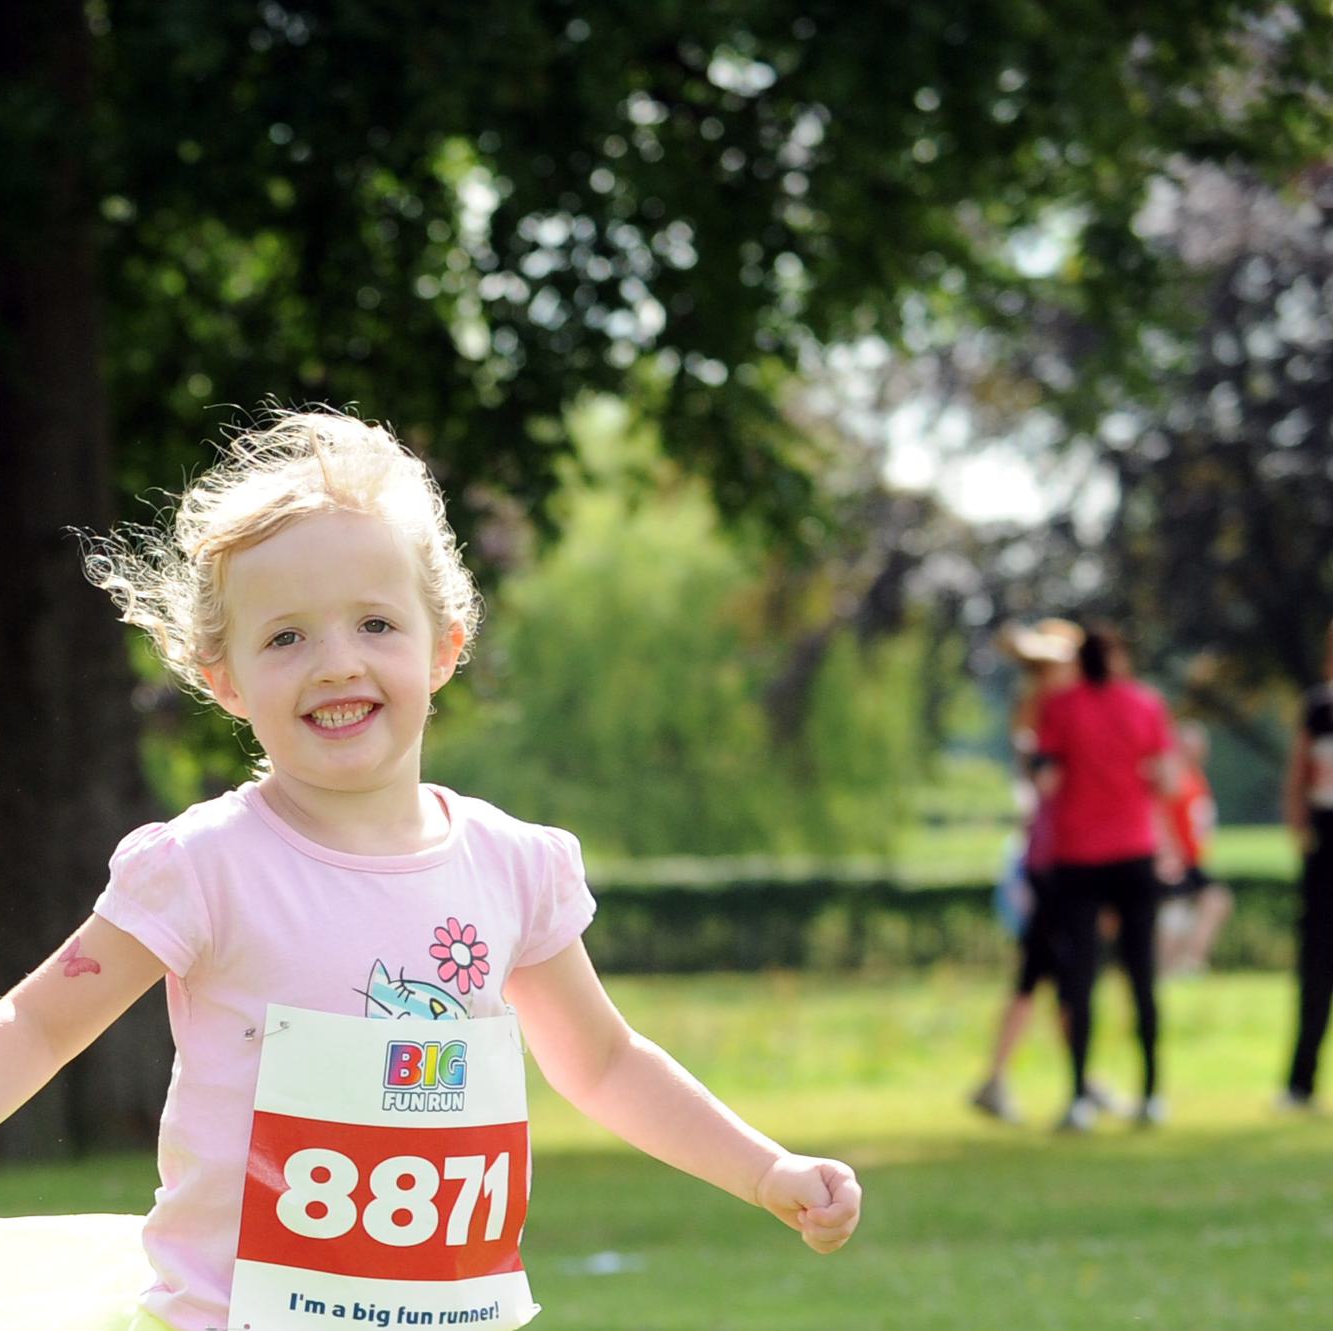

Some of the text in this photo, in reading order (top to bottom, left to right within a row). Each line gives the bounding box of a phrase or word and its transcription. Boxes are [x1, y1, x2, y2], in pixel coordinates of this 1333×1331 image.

[383, 1039, 468, 1091] BIG
[382, 1090, 465, 1112] FUN RUN
[276, 1147, 510, 1247] 8871
[289, 1293, 500, 1328] I'm a big fun runner!
